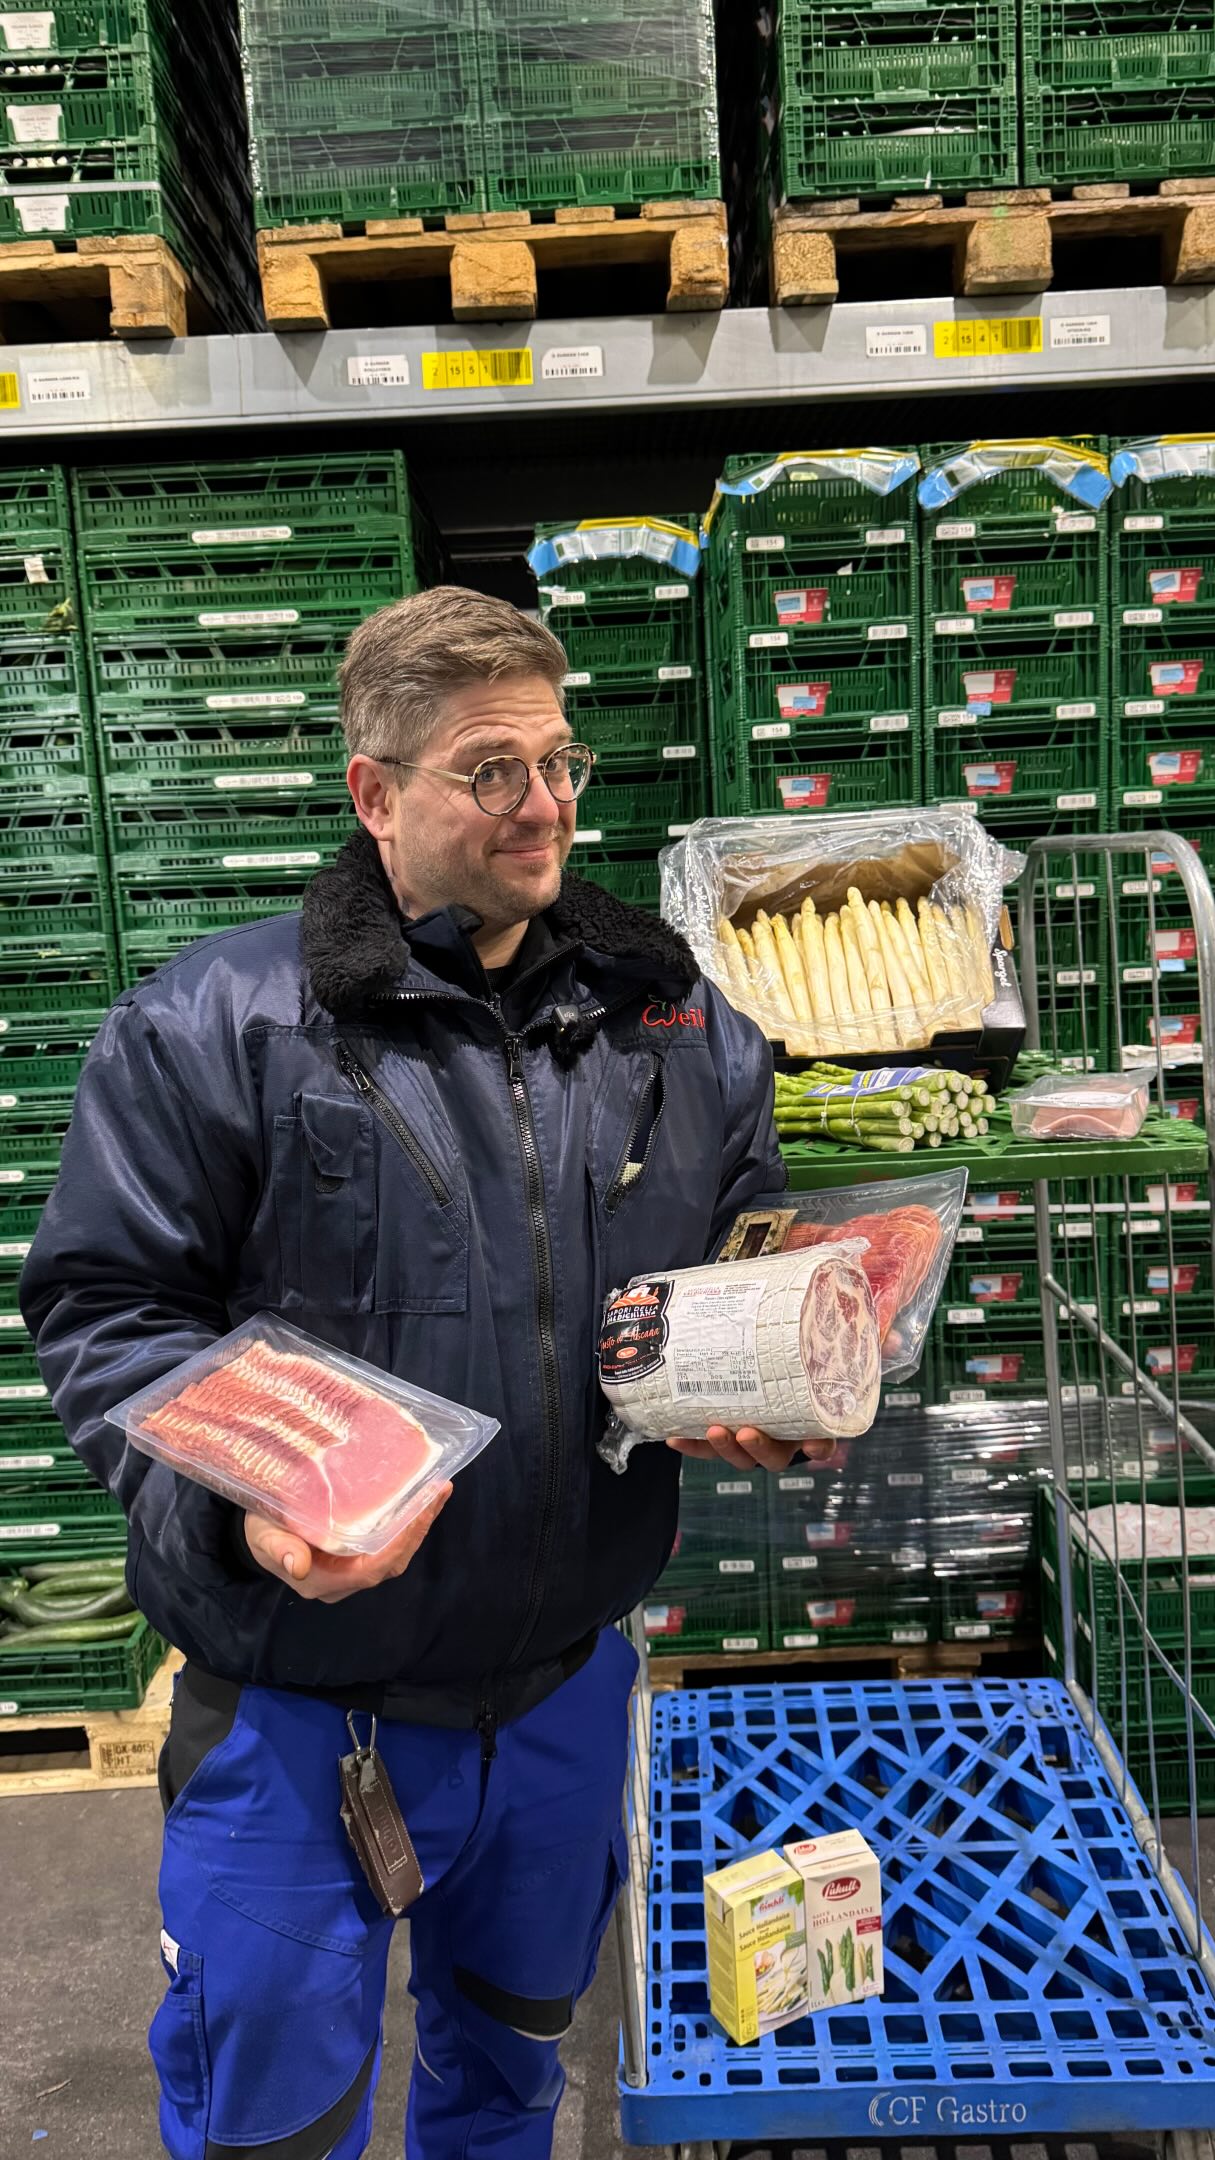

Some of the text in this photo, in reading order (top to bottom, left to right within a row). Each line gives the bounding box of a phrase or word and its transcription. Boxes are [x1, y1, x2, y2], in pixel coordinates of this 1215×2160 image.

[943, 335, 949, 346] 2
[960, 335, 972, 345] 15
[978, 334, 985, 344] 4
[432, 366, 438, 377] 2
[449, 365, 461, 376] 15
[468, 365, 475, 375] 5
[992, 948, 1012, 988] Spargel
[633, 1304, 658, 1312] DELLA
[116, 1755, 131, 1765] HT
[823, 1880, 858, 1899] Lukull
[738, 1912, 791, 1941] Sauce Hollandaise
[812, 1906, 875, 1929] HOLLANDAISE
[739, 1939, 757, 1953] Sauce
[757, 1924, 792, 1943] Hollandaise
[888, 2095, 1028, 2126] CF Gastro
